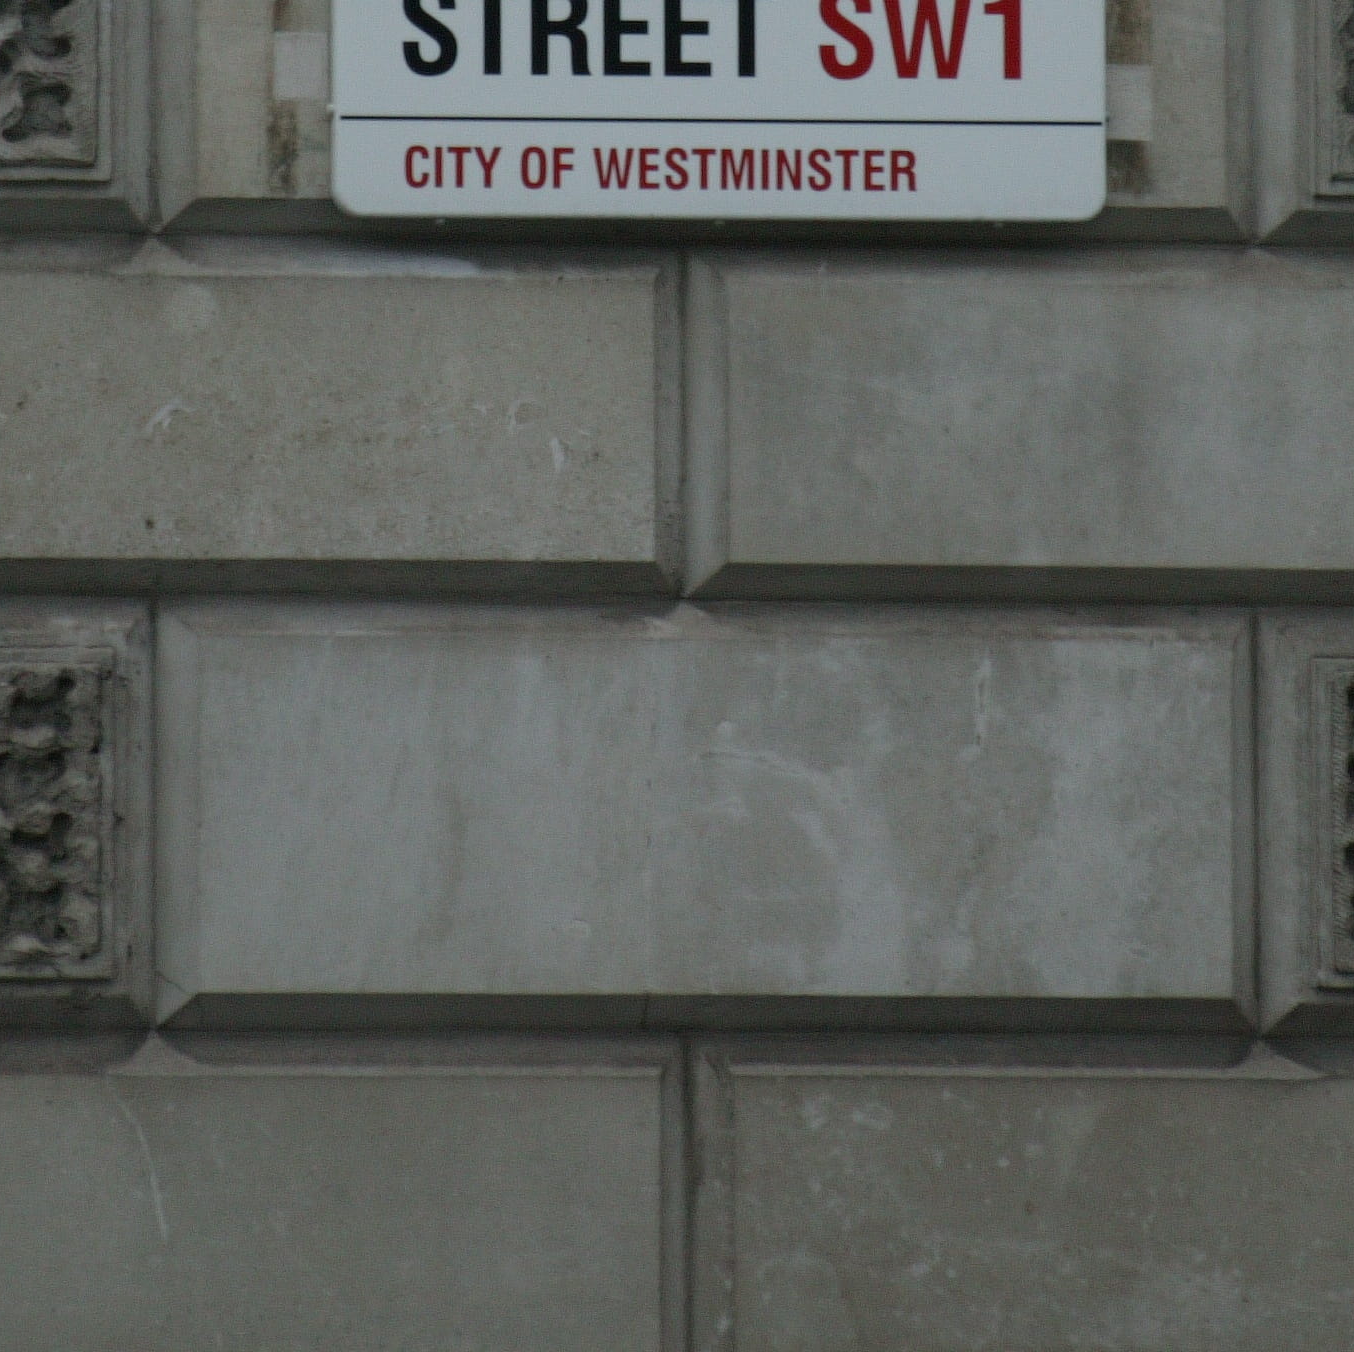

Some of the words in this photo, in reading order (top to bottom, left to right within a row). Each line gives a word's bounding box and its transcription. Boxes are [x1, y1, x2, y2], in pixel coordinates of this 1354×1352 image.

[403, 144, 502, 190] CITY
[520, 145, 575, 191] OF
[592, 146, 918, 193] WESTMINSTER
